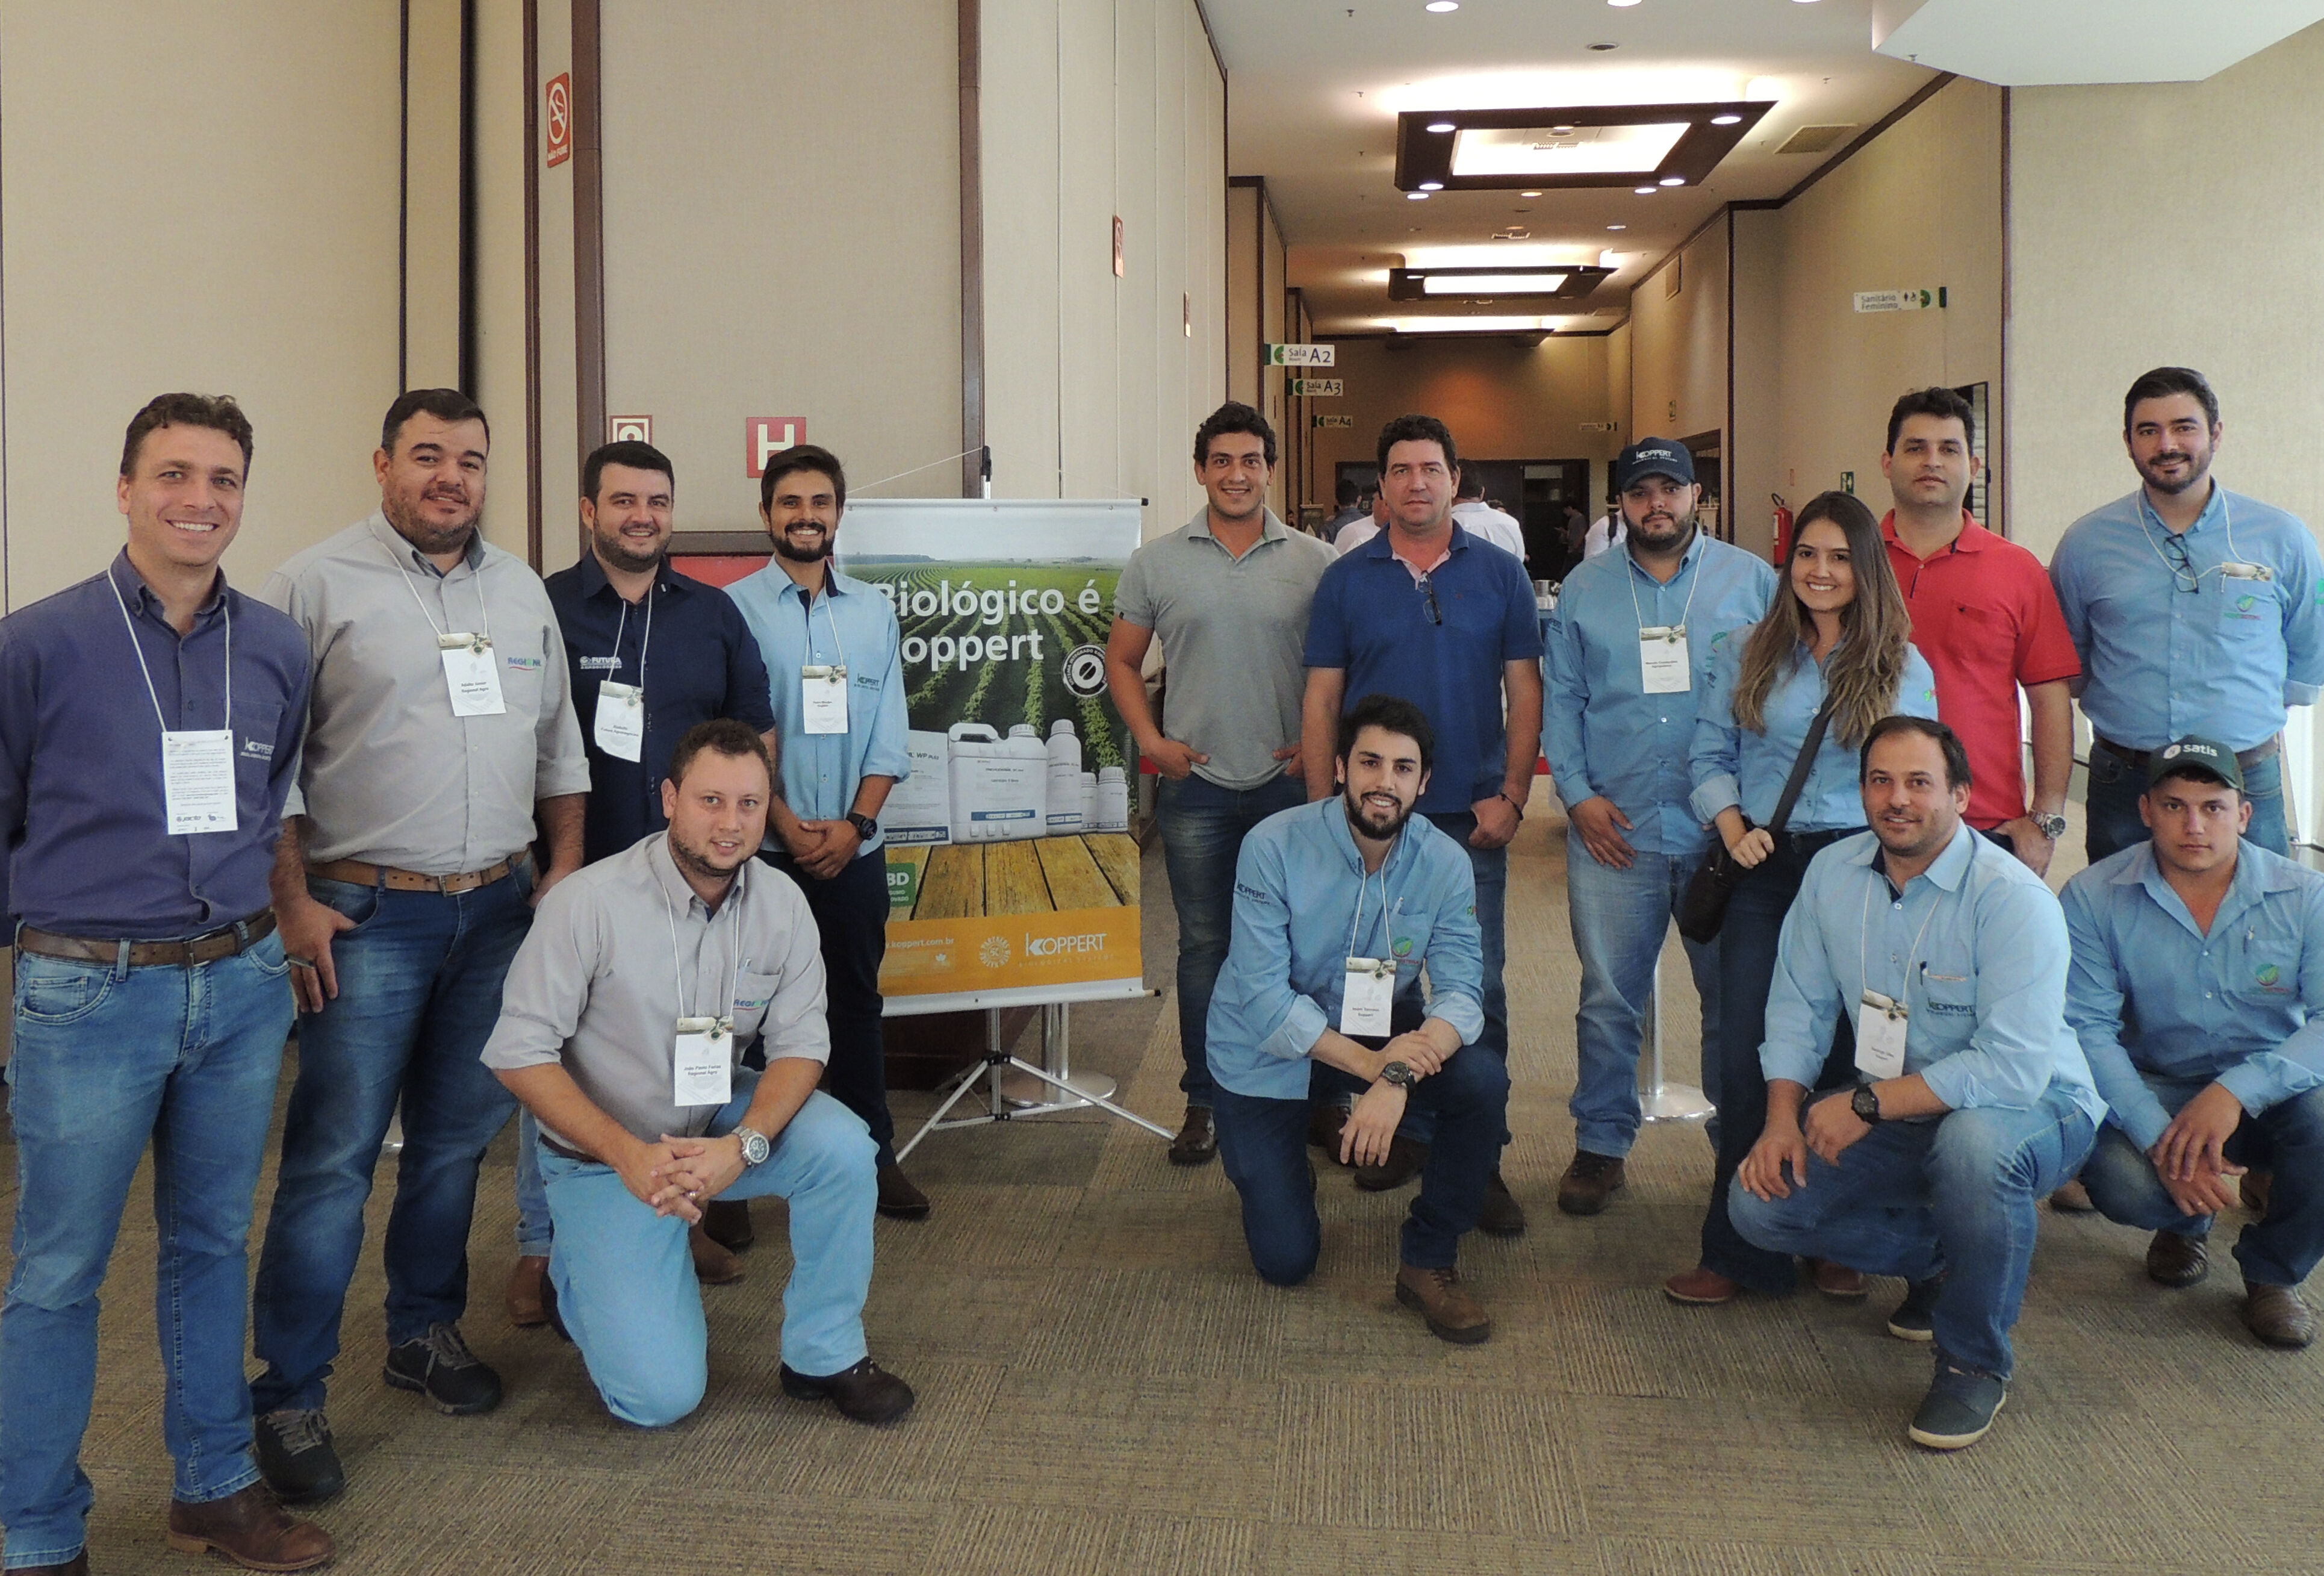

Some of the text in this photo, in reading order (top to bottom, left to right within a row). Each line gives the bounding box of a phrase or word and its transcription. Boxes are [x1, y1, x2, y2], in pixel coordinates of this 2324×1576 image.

[1861, 294, 1897, 302] Sanitário
[1862, 302, 1898, 311] Feminino
[1288, 346, 1331, 363] Sala A2
[1306, 380, 1341, 395] Sala A3
[1339, 416, 1352, 426] A4
[757, 424, 795, 470] H
[1636, 449, 1673, 459] KOPPERT
[1078, 579, 1101, 614] é
[901, 628, 1044, 672] oppert
[2183, 744, 2218, 758] satis
[886, 872, 910, 886] BD
[1237, 878, 1267, 900] KOPPERT
[1025, 932, 1108, 956] KOPPERT
[1928, 997, 1974, 1014] KOPPERT
